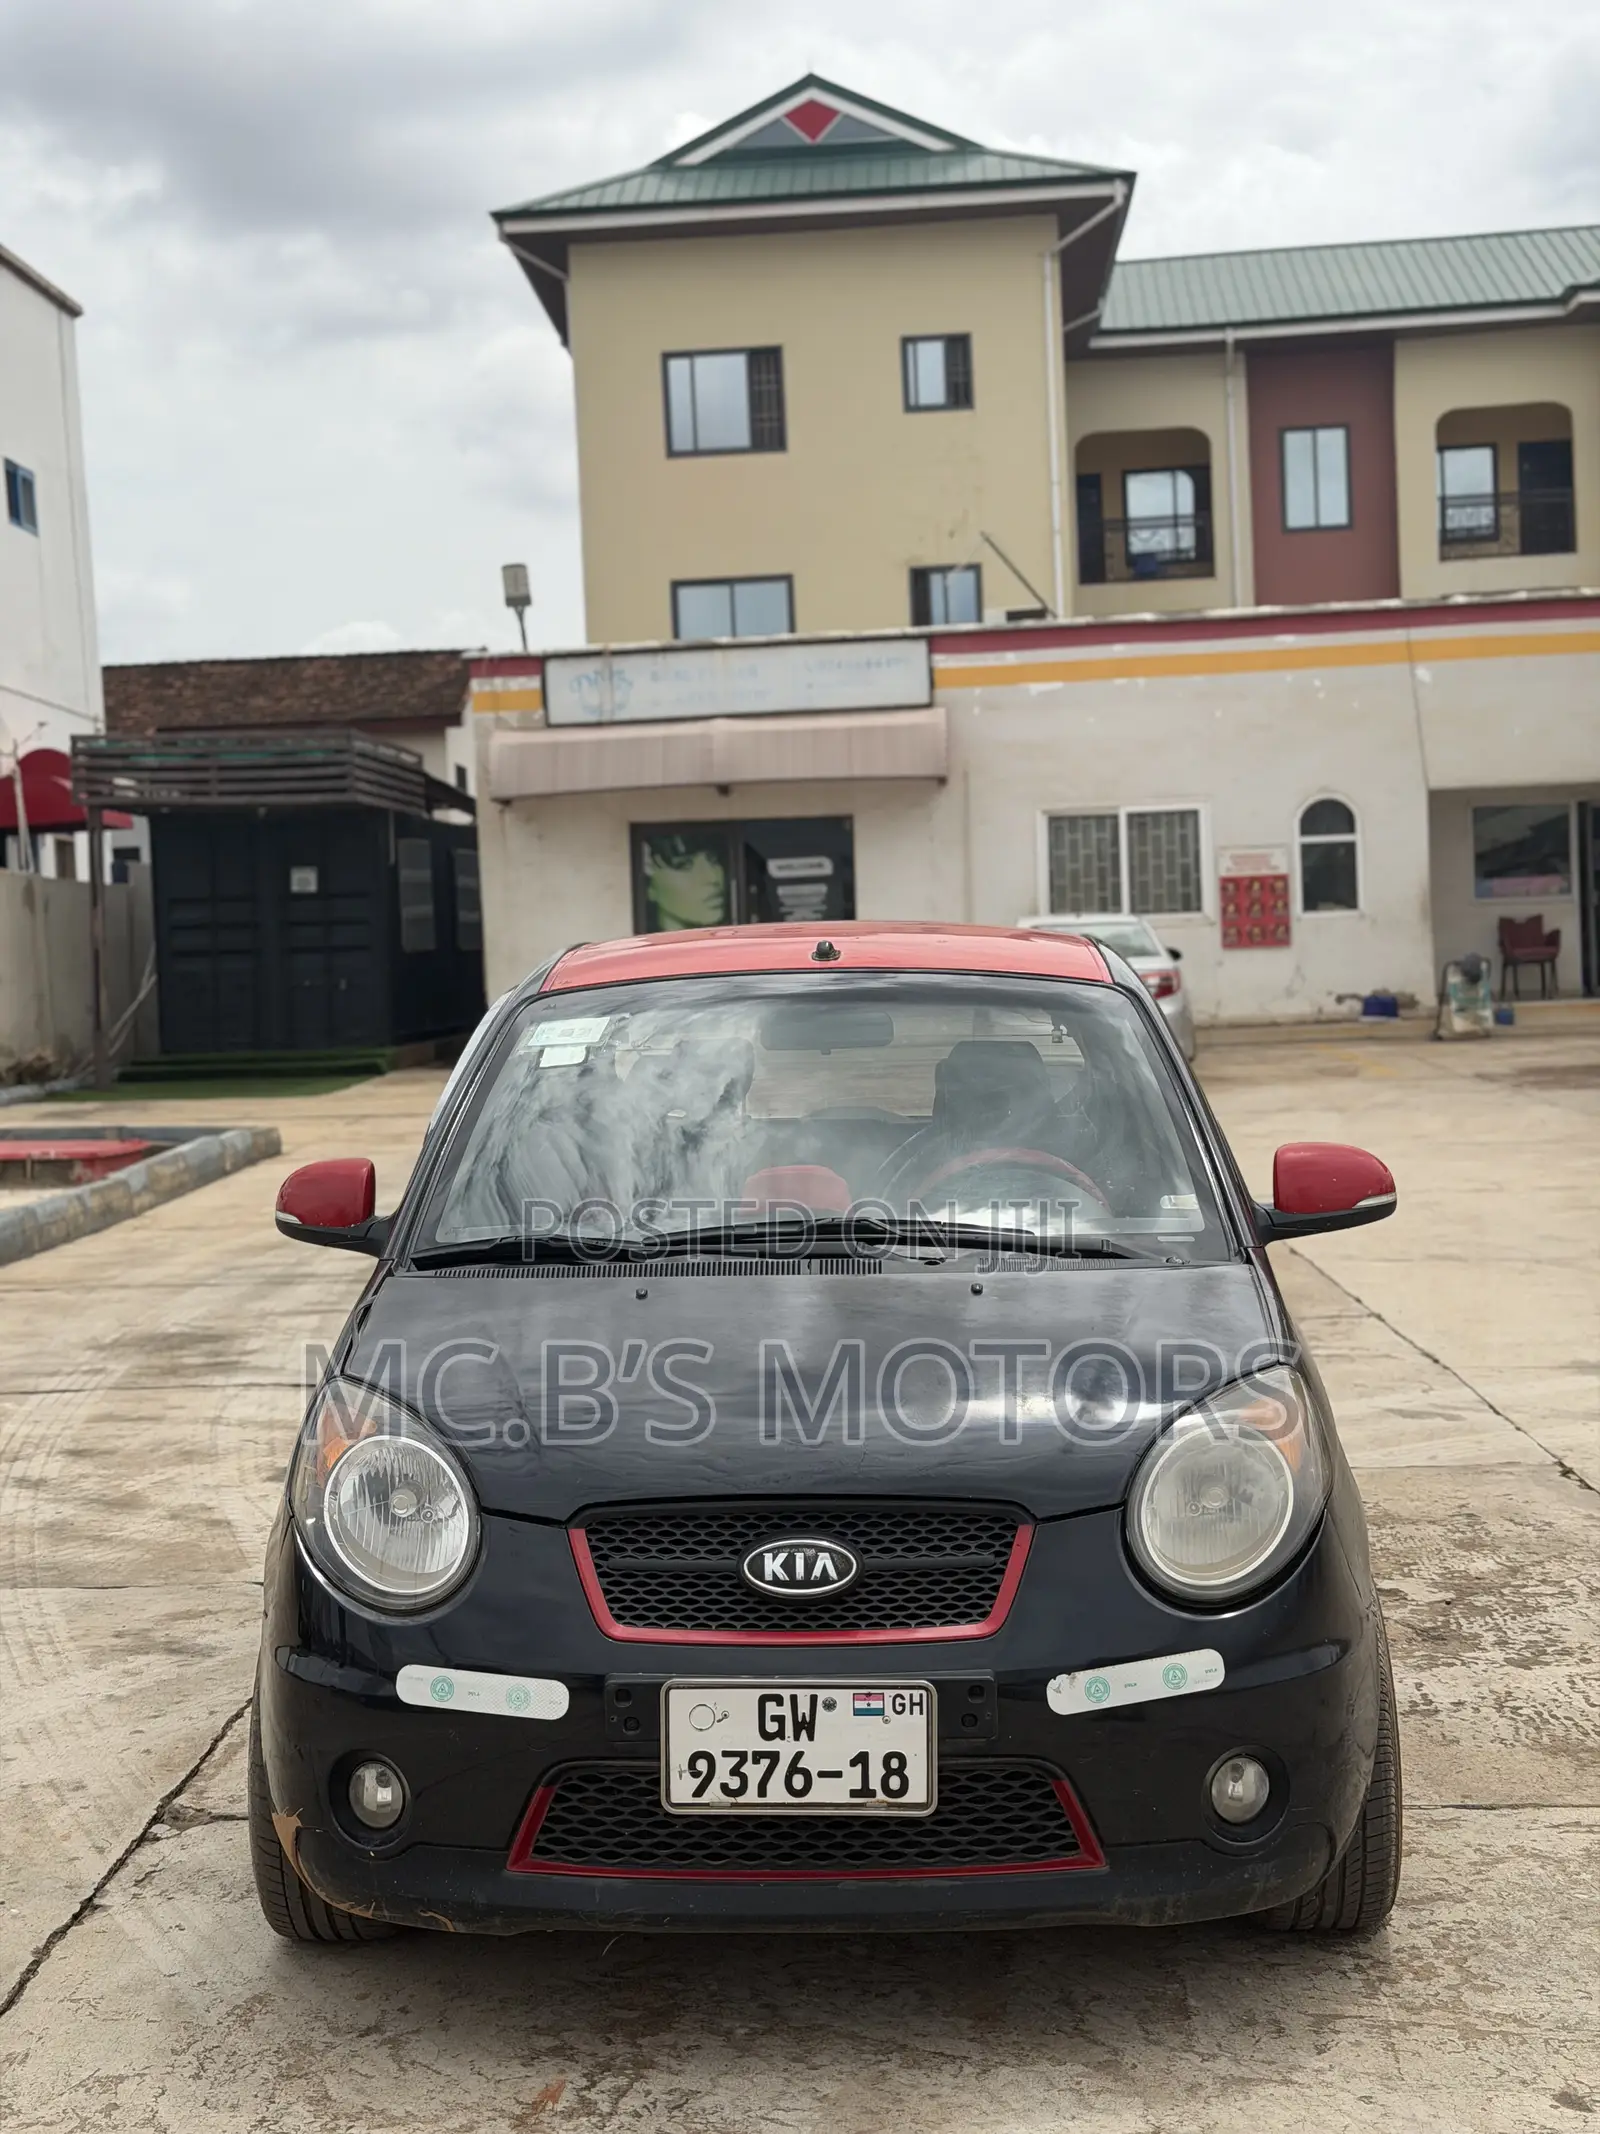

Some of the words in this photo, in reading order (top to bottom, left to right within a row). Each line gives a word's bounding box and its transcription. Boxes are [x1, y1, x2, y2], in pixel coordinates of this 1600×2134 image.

[762, 1552, 839, 1581] KIA
[757, 1692, 819, 1742] GW
[890, 1692, 925, 1716] GH
[687, 1749, 910, 1799] 9376-18
